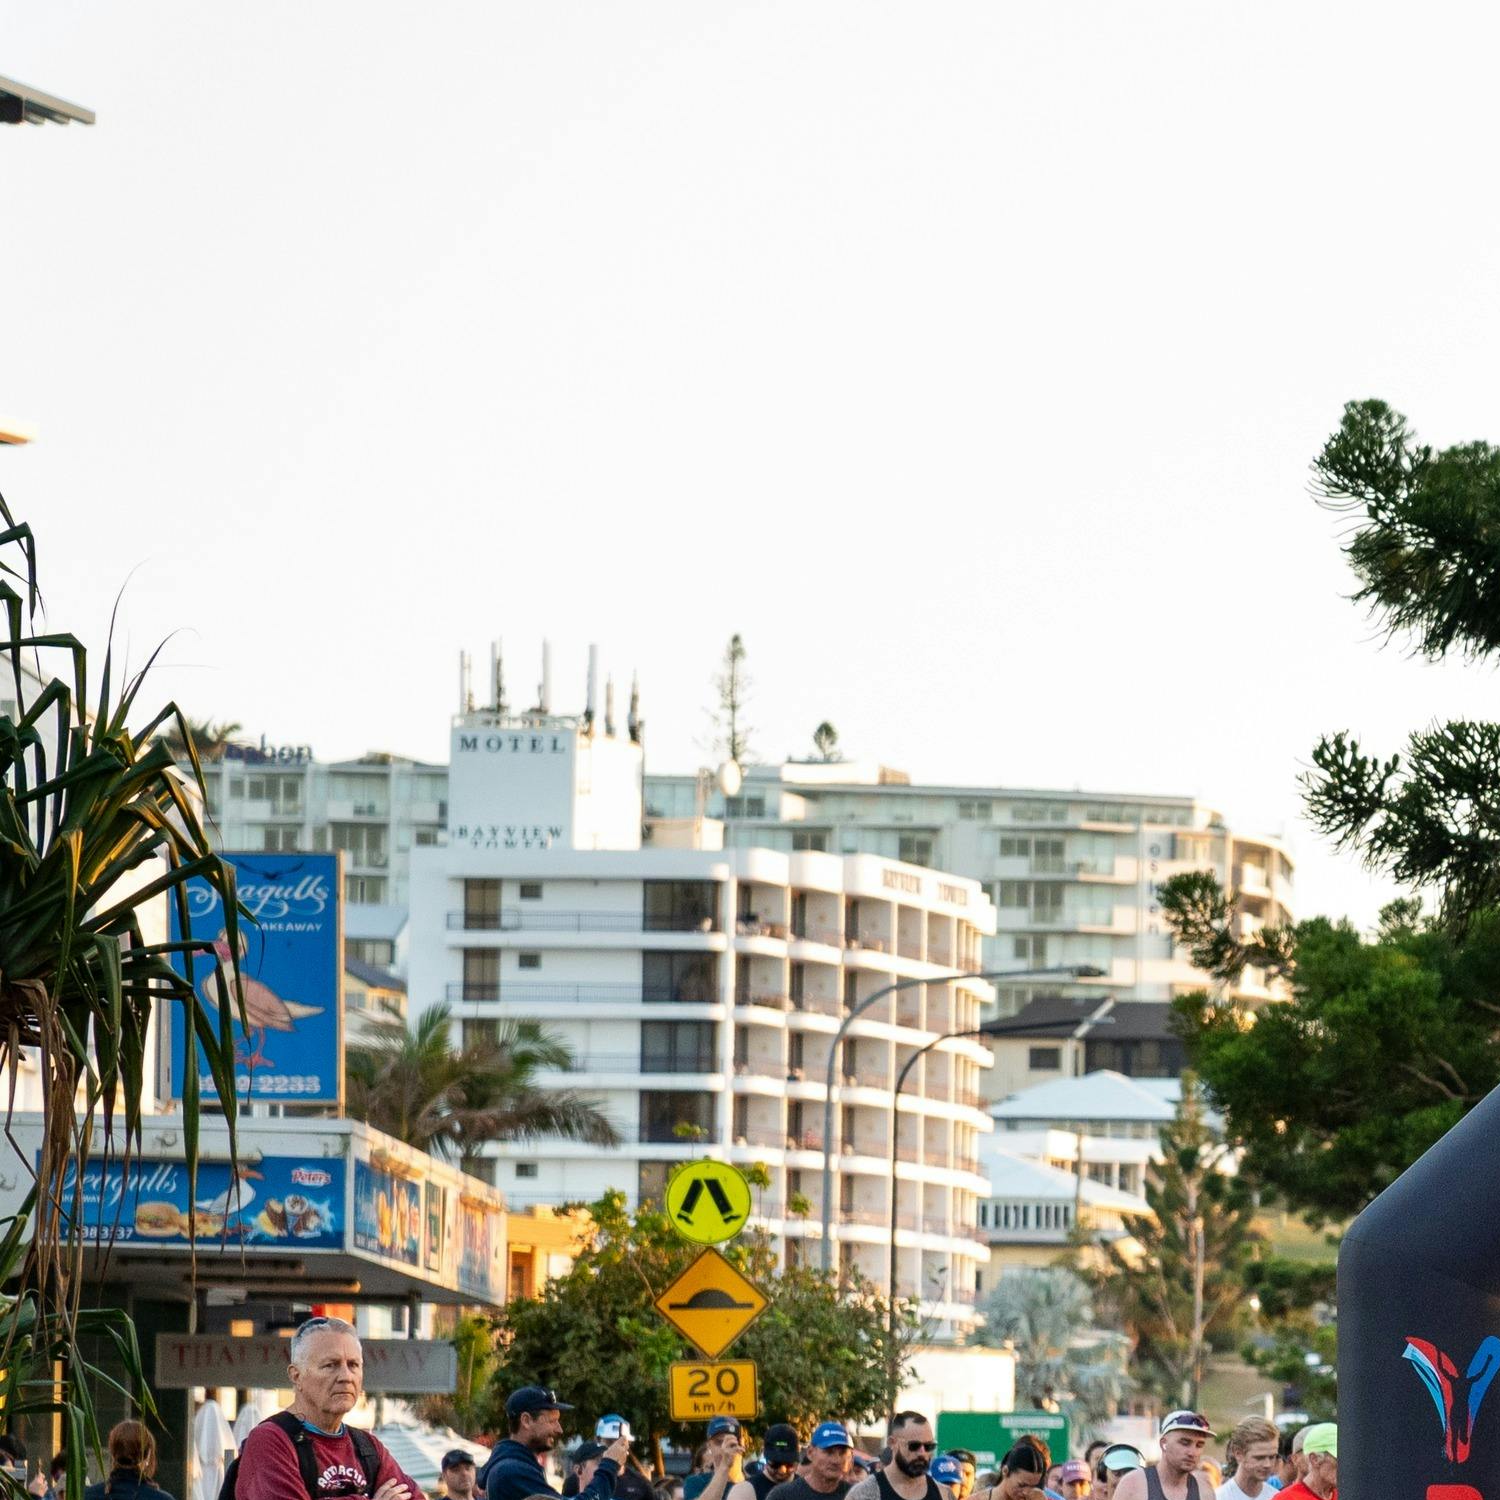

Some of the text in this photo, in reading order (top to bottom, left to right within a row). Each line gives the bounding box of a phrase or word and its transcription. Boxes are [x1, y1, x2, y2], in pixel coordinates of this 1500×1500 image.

[459, 735, 565, 753] MOTEL
[458, 825, 563, 839] BAYVIEW
[176, 875, 330, 918] Sagulls
[255, 922, 322, 932] TAKEAWAY
[259, 1075, 321, 1093] 2233
[172, 1342, 432, 1371] THAI TAWAY
[688, 1368, 739, 1397] 20
[693, 1401, 736, 1412] km/h
[318, 1464, 367, 1488] ANTARCTIC
